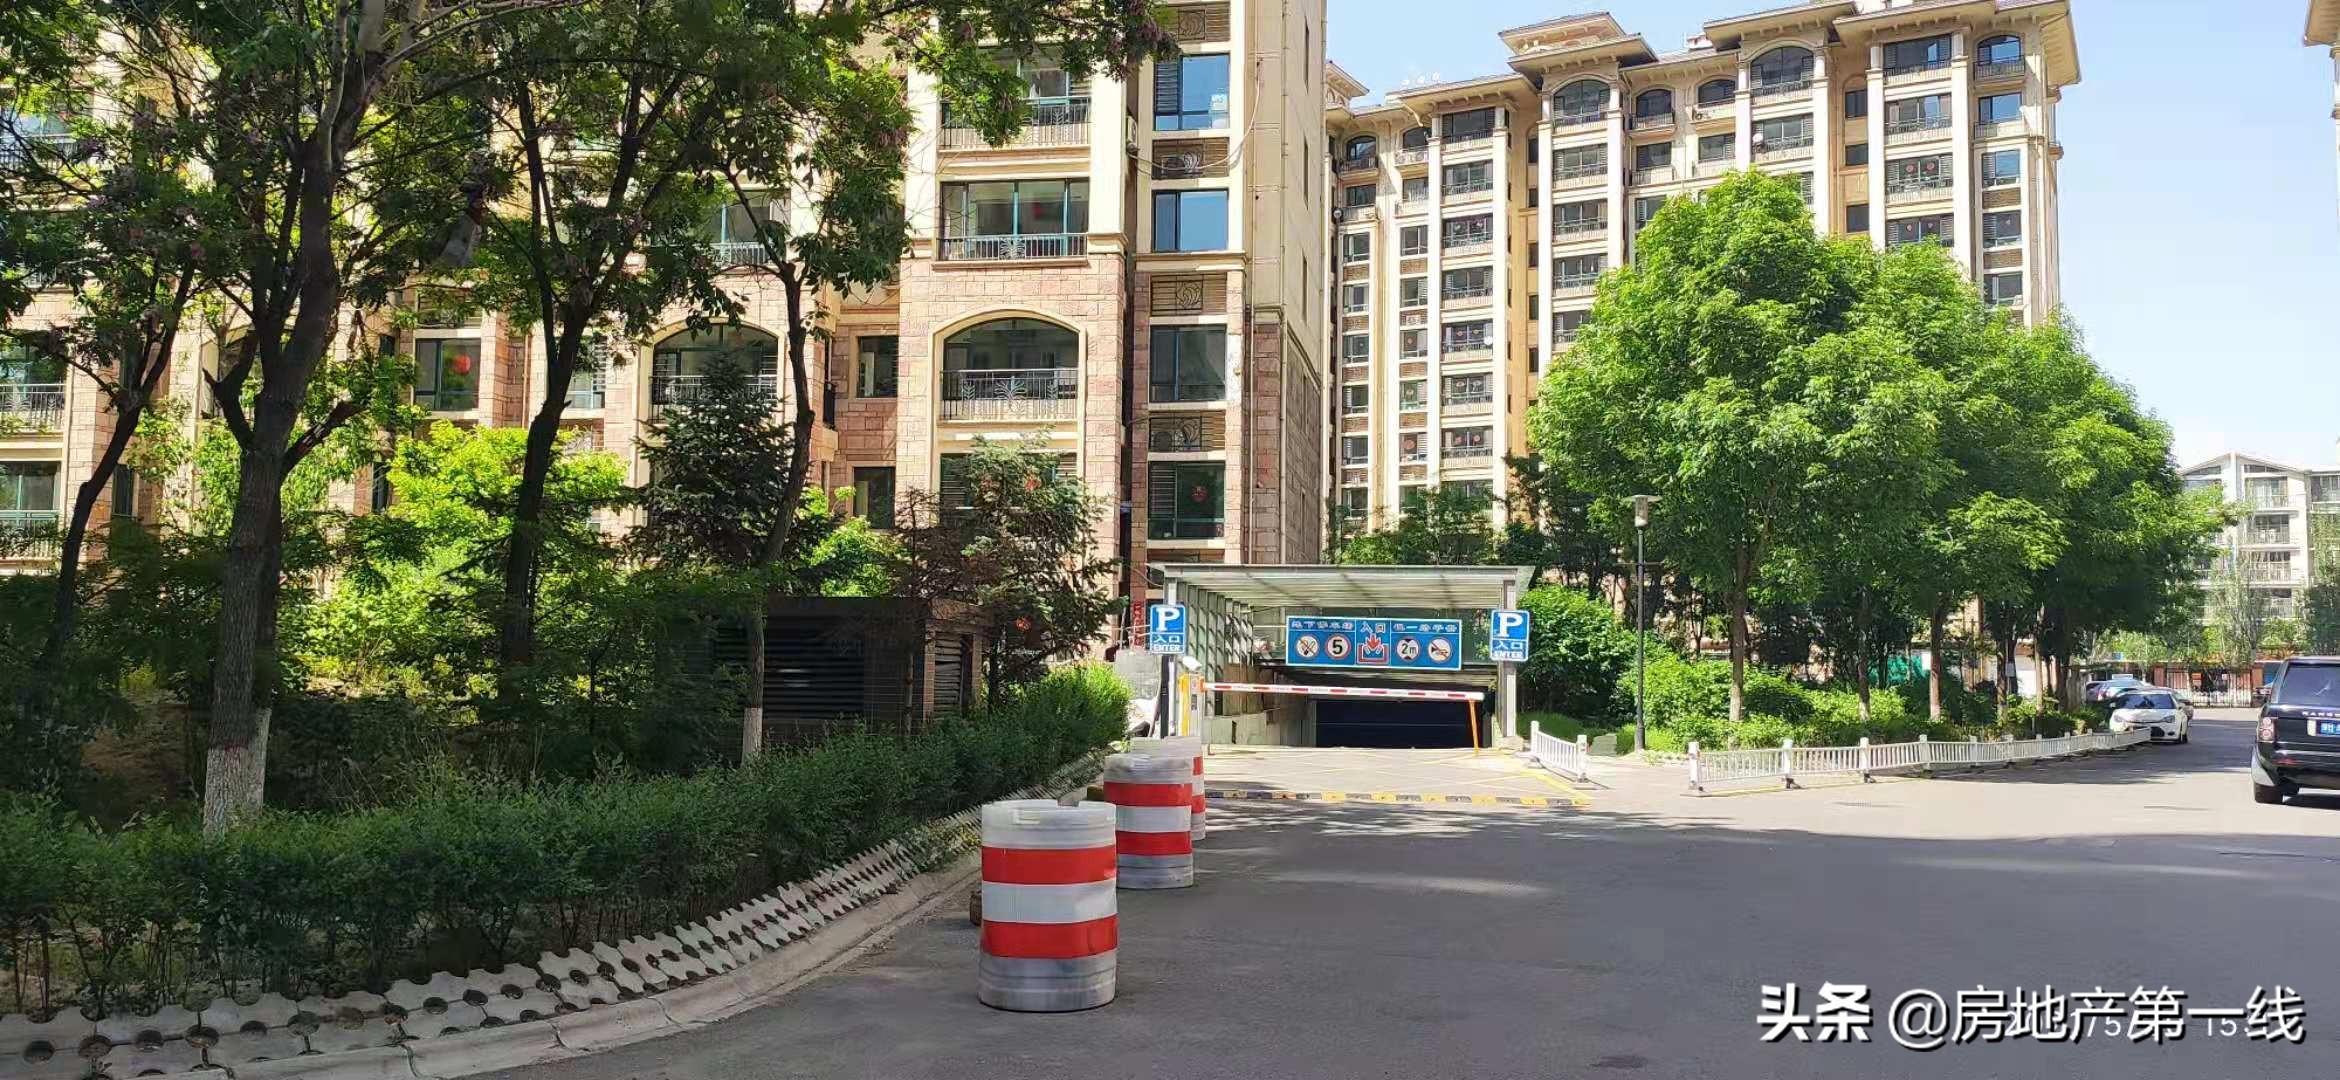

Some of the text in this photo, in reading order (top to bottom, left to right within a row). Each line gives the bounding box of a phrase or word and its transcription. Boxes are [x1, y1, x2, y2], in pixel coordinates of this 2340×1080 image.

[1155, 607, 1181, 632] P
[1494, 612, 1524, 637] P
[1360, 620, 1386, 634] 入口
[1153, 635, 1180, 643] 入口
[1494, 640, 1523, 650] 入口
[1153, 644, 1181, 652] ENTER
[1332, 639, 1344, 655] 5
